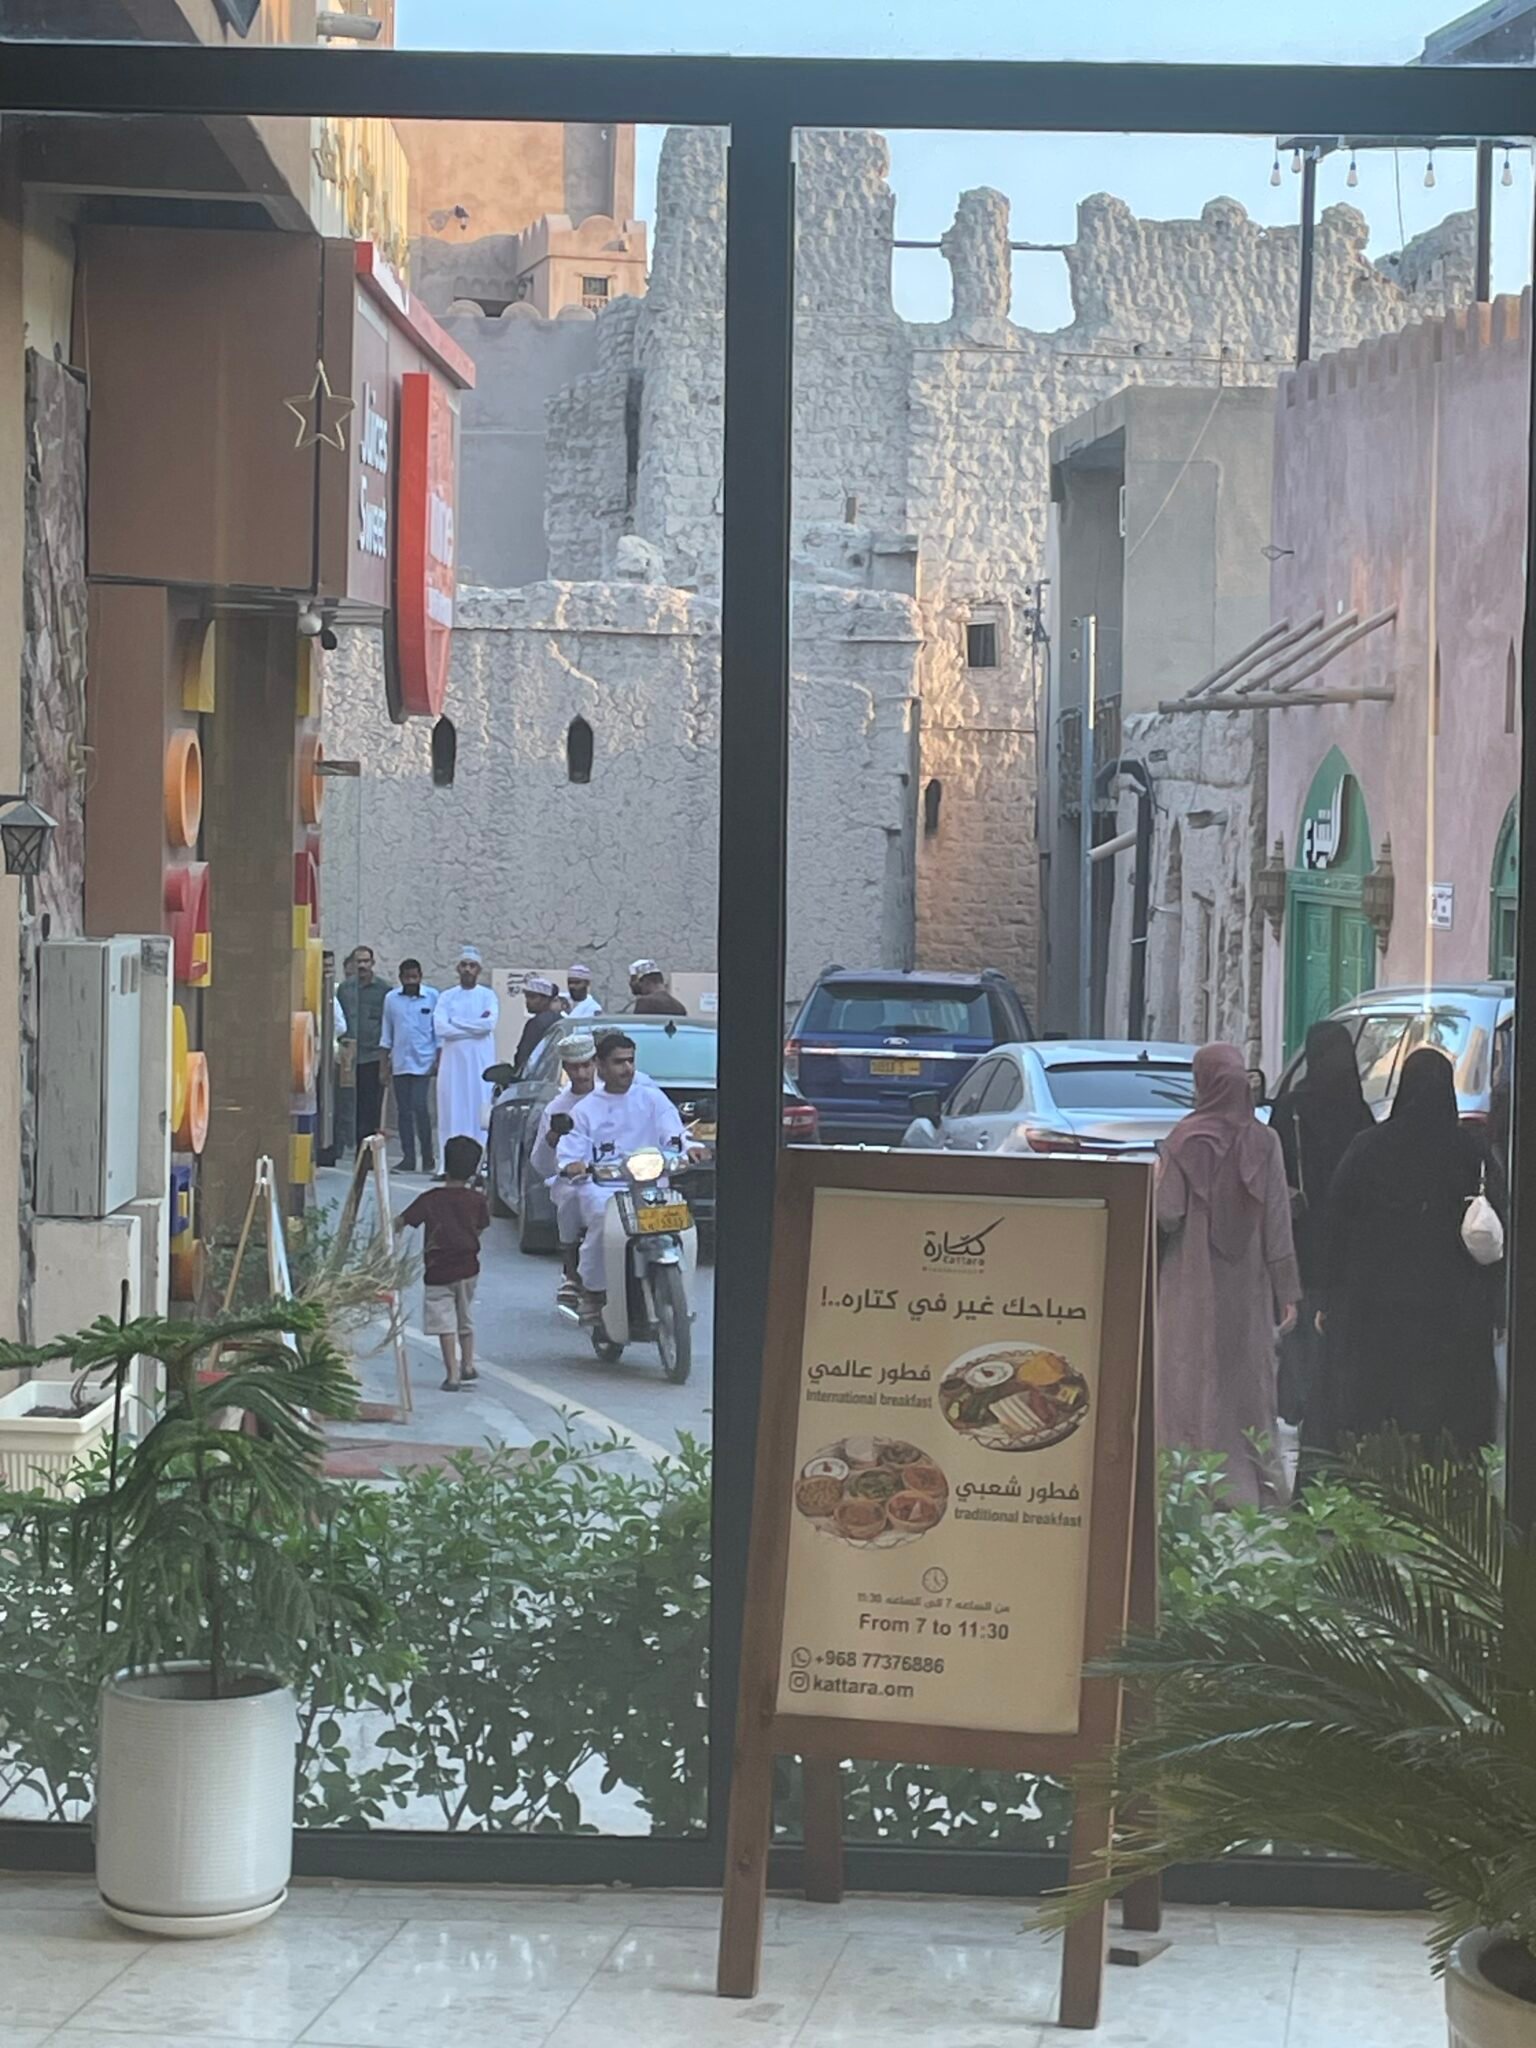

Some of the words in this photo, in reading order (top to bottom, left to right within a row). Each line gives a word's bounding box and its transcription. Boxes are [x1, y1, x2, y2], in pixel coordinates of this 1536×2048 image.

[907, 1292, 947, 1322] في
[953, 1296, 995, 1321] غير
[1002, 1296, 1087, 1325] صباحك
[807, 1359, 873, 1384] عالمي
[877, 1363, 931, 1386] فطور
[806, 1388, 877, 1405] International
[880, 1391, 932, 1408] breakfast
[954, 1474, 1021, 1502] شعبي
[1026, 1481, 1080, 1503] فطور
[954, 1507, 1019, 1523] traditional
[1022, 1511, 1082, 1528] breakfast
[858, 1613, 909, 1633] From
[916, 1617, 927, 1634] 7
[932, 1618, 951, 1636] to
[958, 1620, 1009, 1640] 11:30
[815, 1649, 857, 1667] +968
[862, 1652, 945, 1674] 77376886
[813, 1674, 914, 1698] kattara.om
